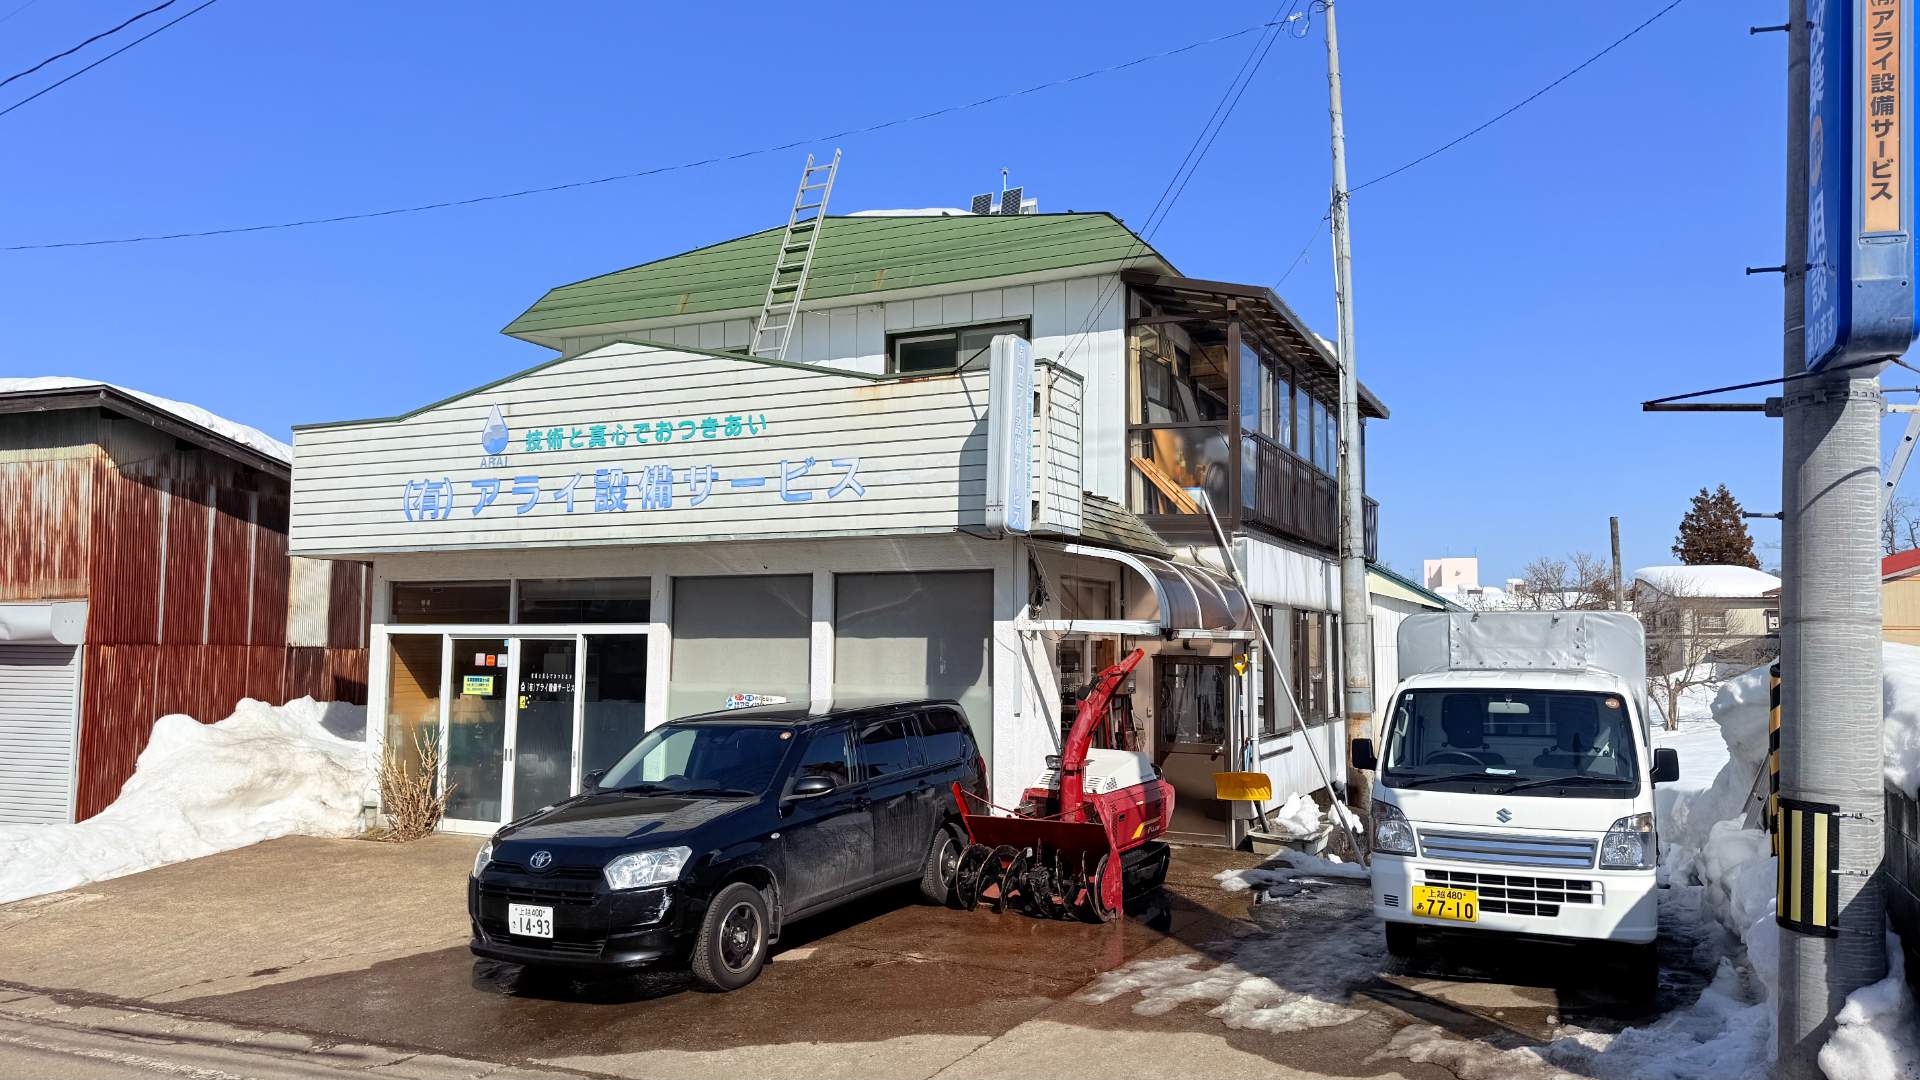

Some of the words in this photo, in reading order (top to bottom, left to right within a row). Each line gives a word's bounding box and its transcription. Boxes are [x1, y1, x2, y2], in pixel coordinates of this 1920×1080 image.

[1869, 0, 1895, 201] アライ設備サービス
[525, 414, 768, 452] 技術と真心でおつきあい
[480, 456, 508, 468] ARAI
[403, 456, 867, 521] (有)アライ設備サービス
[1427, 899, 1473, 919] 77-10
